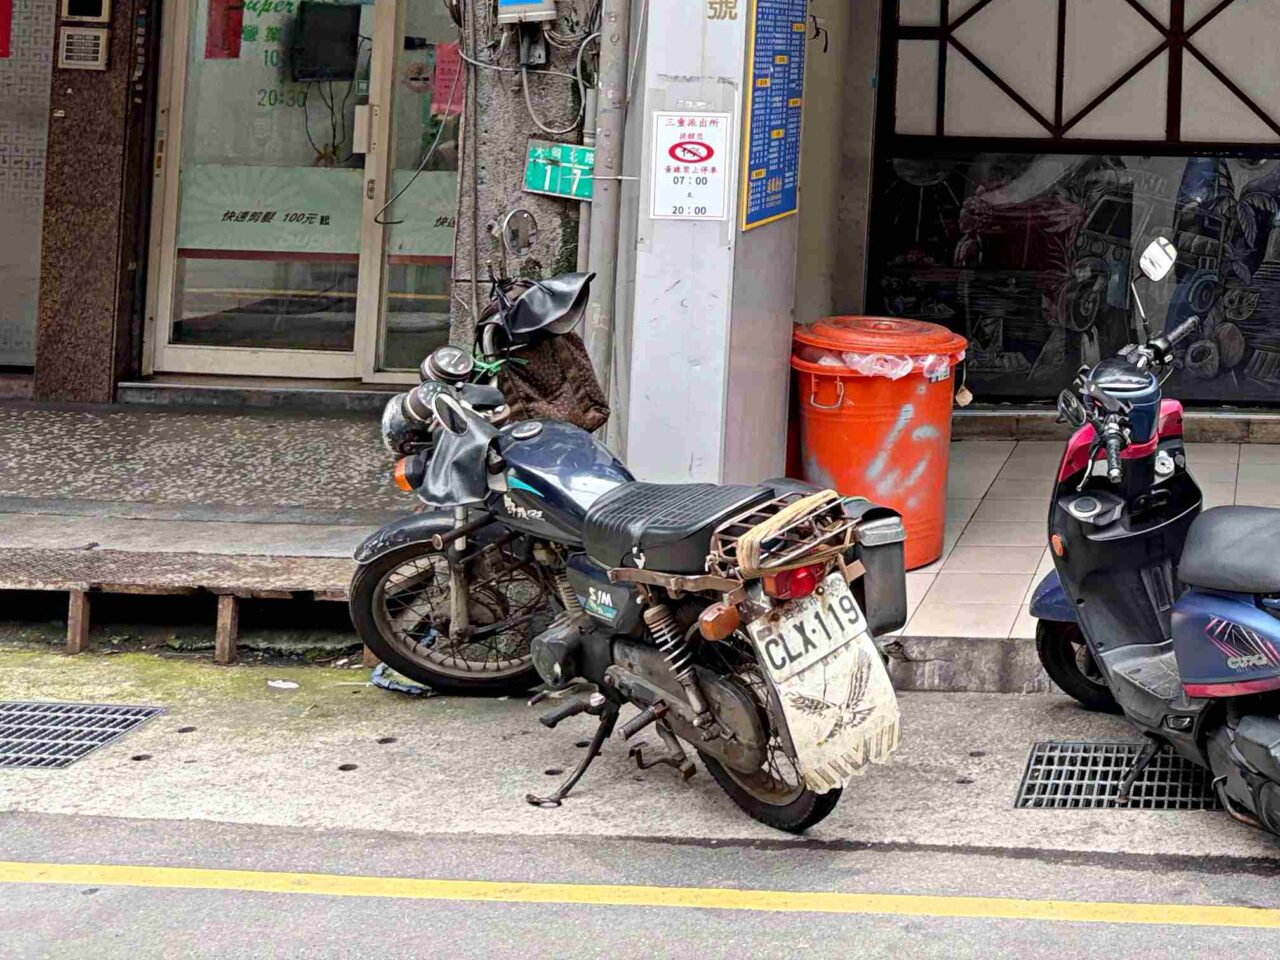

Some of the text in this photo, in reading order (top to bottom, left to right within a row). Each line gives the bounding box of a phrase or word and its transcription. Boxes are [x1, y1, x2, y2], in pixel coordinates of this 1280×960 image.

[665, 117, 719, 128] 三重派出所
[543, 165, 581, 196] 17
